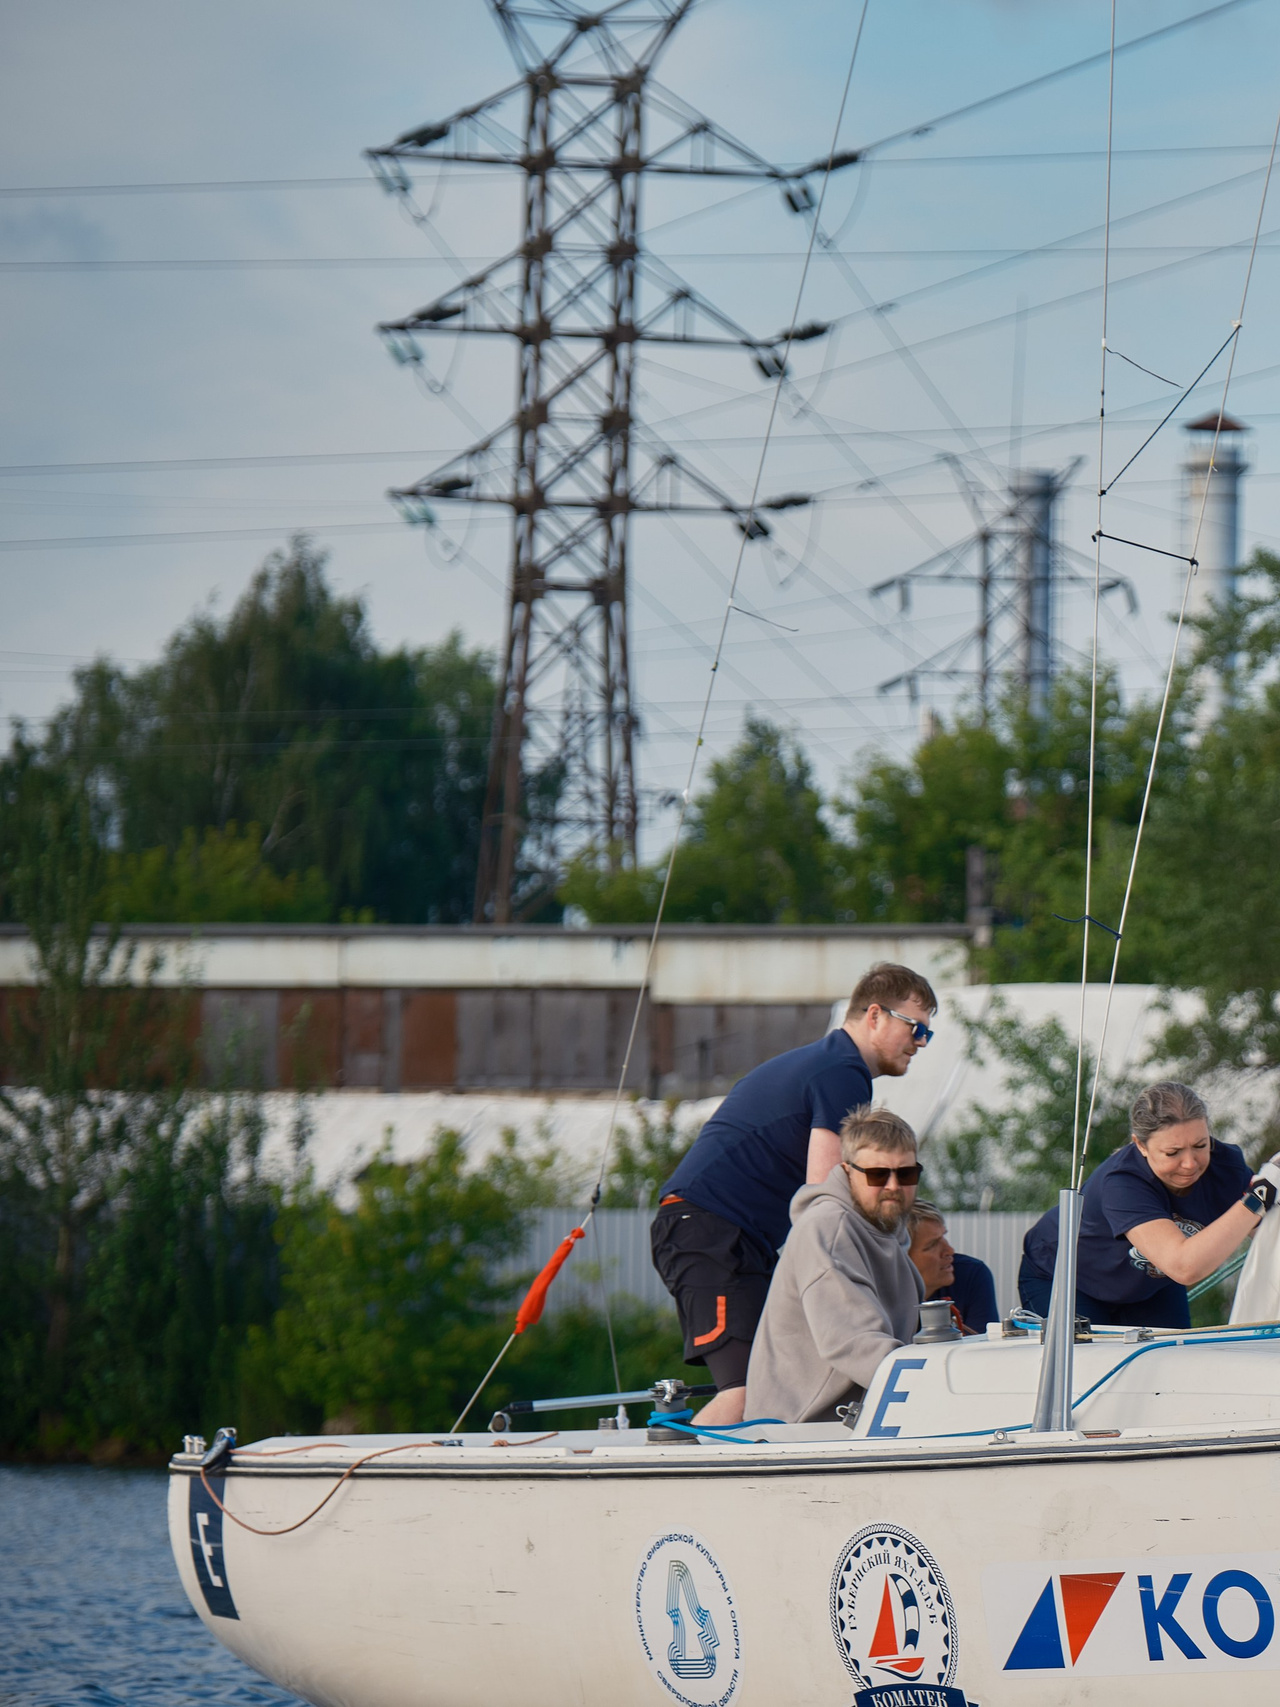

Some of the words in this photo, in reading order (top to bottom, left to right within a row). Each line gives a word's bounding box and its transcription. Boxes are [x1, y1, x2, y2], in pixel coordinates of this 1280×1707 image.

[866, 1358, 928, 1438] E
[195, 1512, 224, 1588] E
[635, 1561, 654, 1661] МИНИСТЕРСТВО
[646, 1533, 694, 1561] ФИЗИЧЕСКОЙ
[695, 1541, 729, 1593] КУЛЬТУРЫ
[726, 1595, 734, 1606] И
[730, 1609, 741, 1661] СПОРТА
[847, 1549, 891, 1631] ГУБЕРНСКИЙ
[894, 1555, 938, 1625] ЯХТ-КЛУБ
[718, 1668, 740, 1707] ОБЛАСТИ
[870, 1689, 948, 1707] КОМАТЕК
